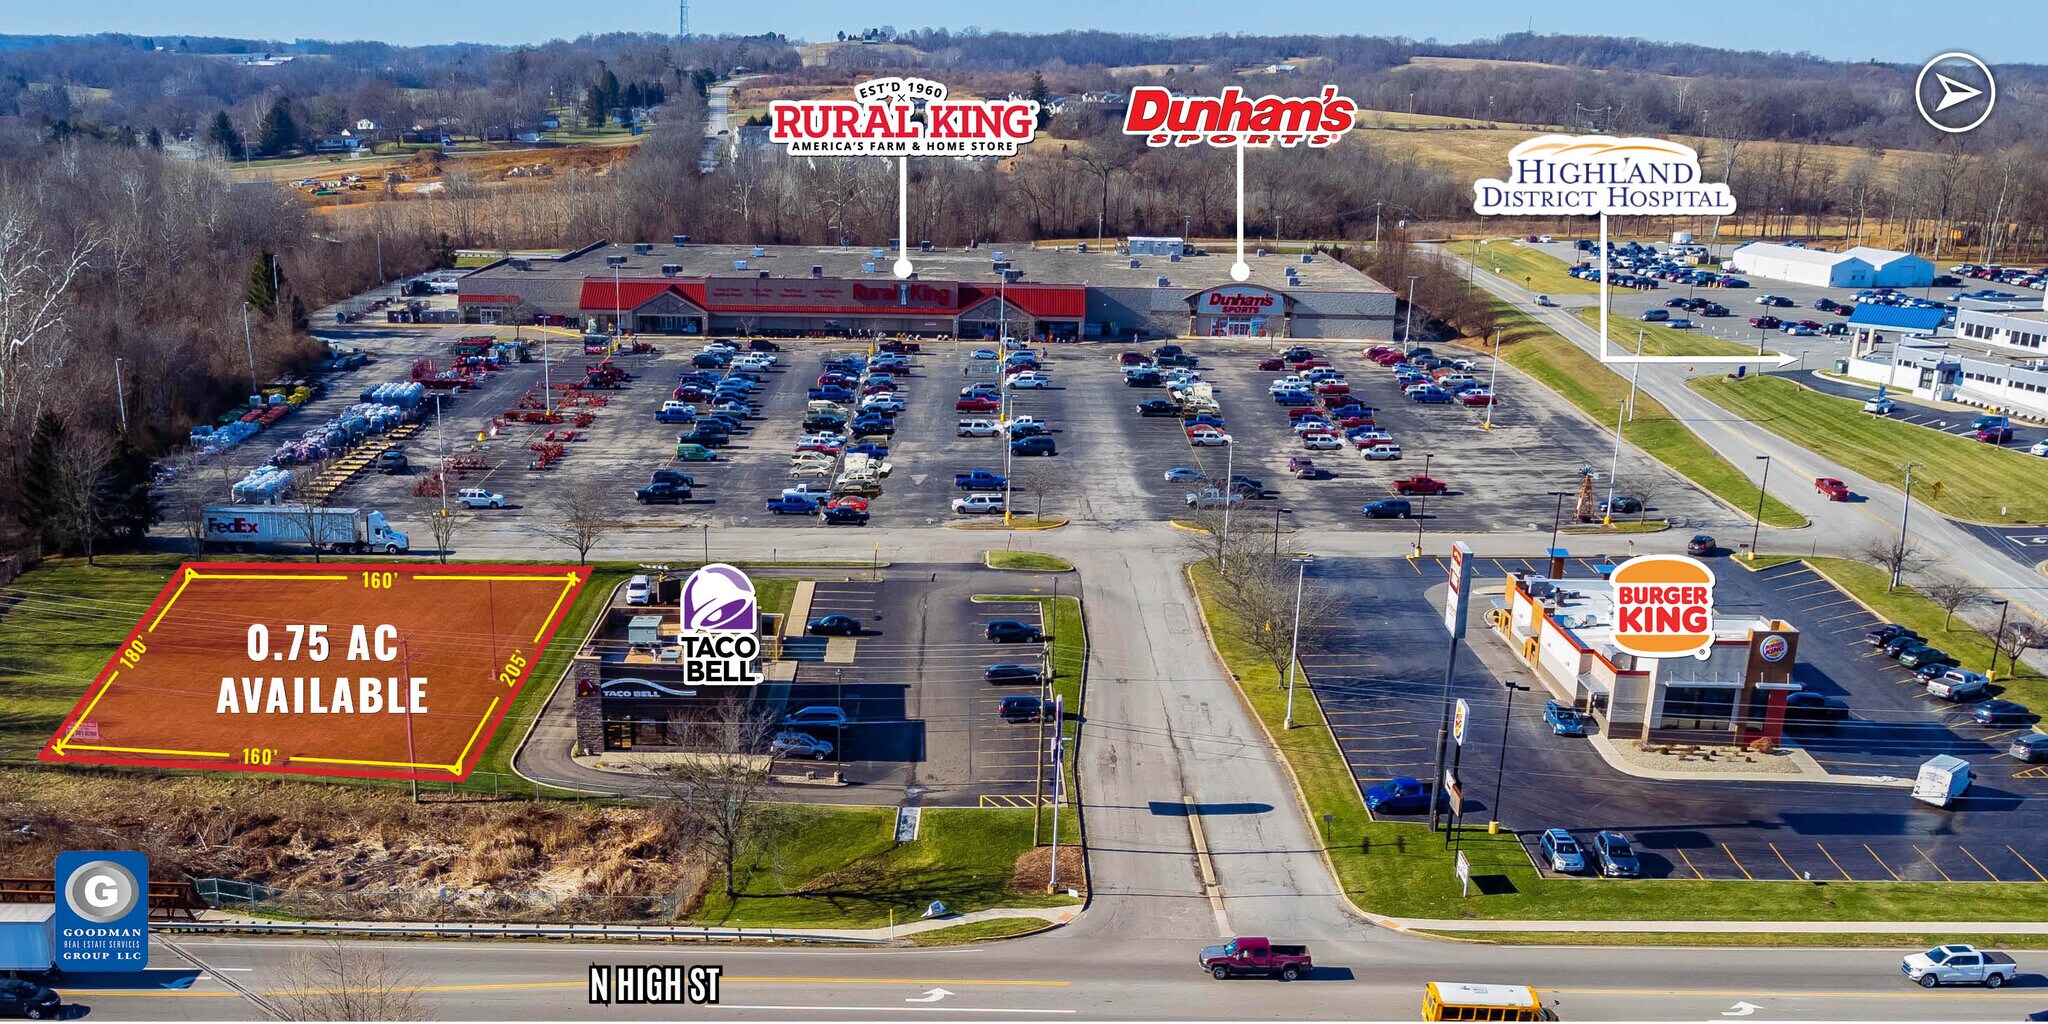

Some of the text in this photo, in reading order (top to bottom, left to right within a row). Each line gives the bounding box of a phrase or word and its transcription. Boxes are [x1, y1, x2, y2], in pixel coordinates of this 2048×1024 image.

[853, 283, 898, 300] Rural
[910, 284, 951, 306] King
[1209, 293, 1274, 306] Dunham's
[1221, 306, 1260, 314] SPORTS
[208, 517, 259, 534] FedEx
